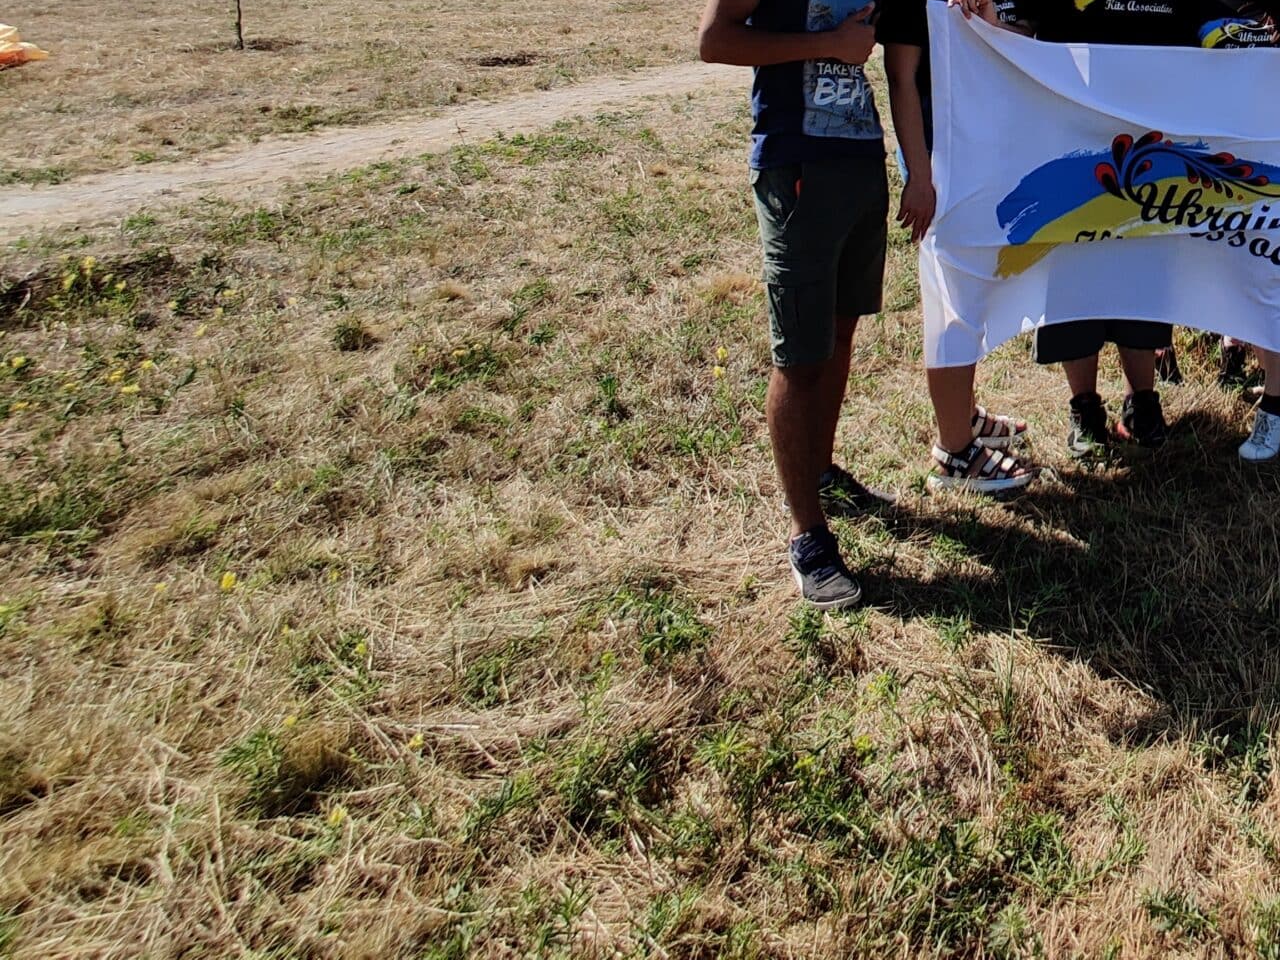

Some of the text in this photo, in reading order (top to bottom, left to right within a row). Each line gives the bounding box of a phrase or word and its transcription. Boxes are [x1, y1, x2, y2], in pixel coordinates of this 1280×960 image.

[1105, 0, 1125, 11] Kite
[1238, 31, 1276, 43] Ukrain
[816, 62, 849, 76] TAKE
[814, 77, 869, 109] BEA
